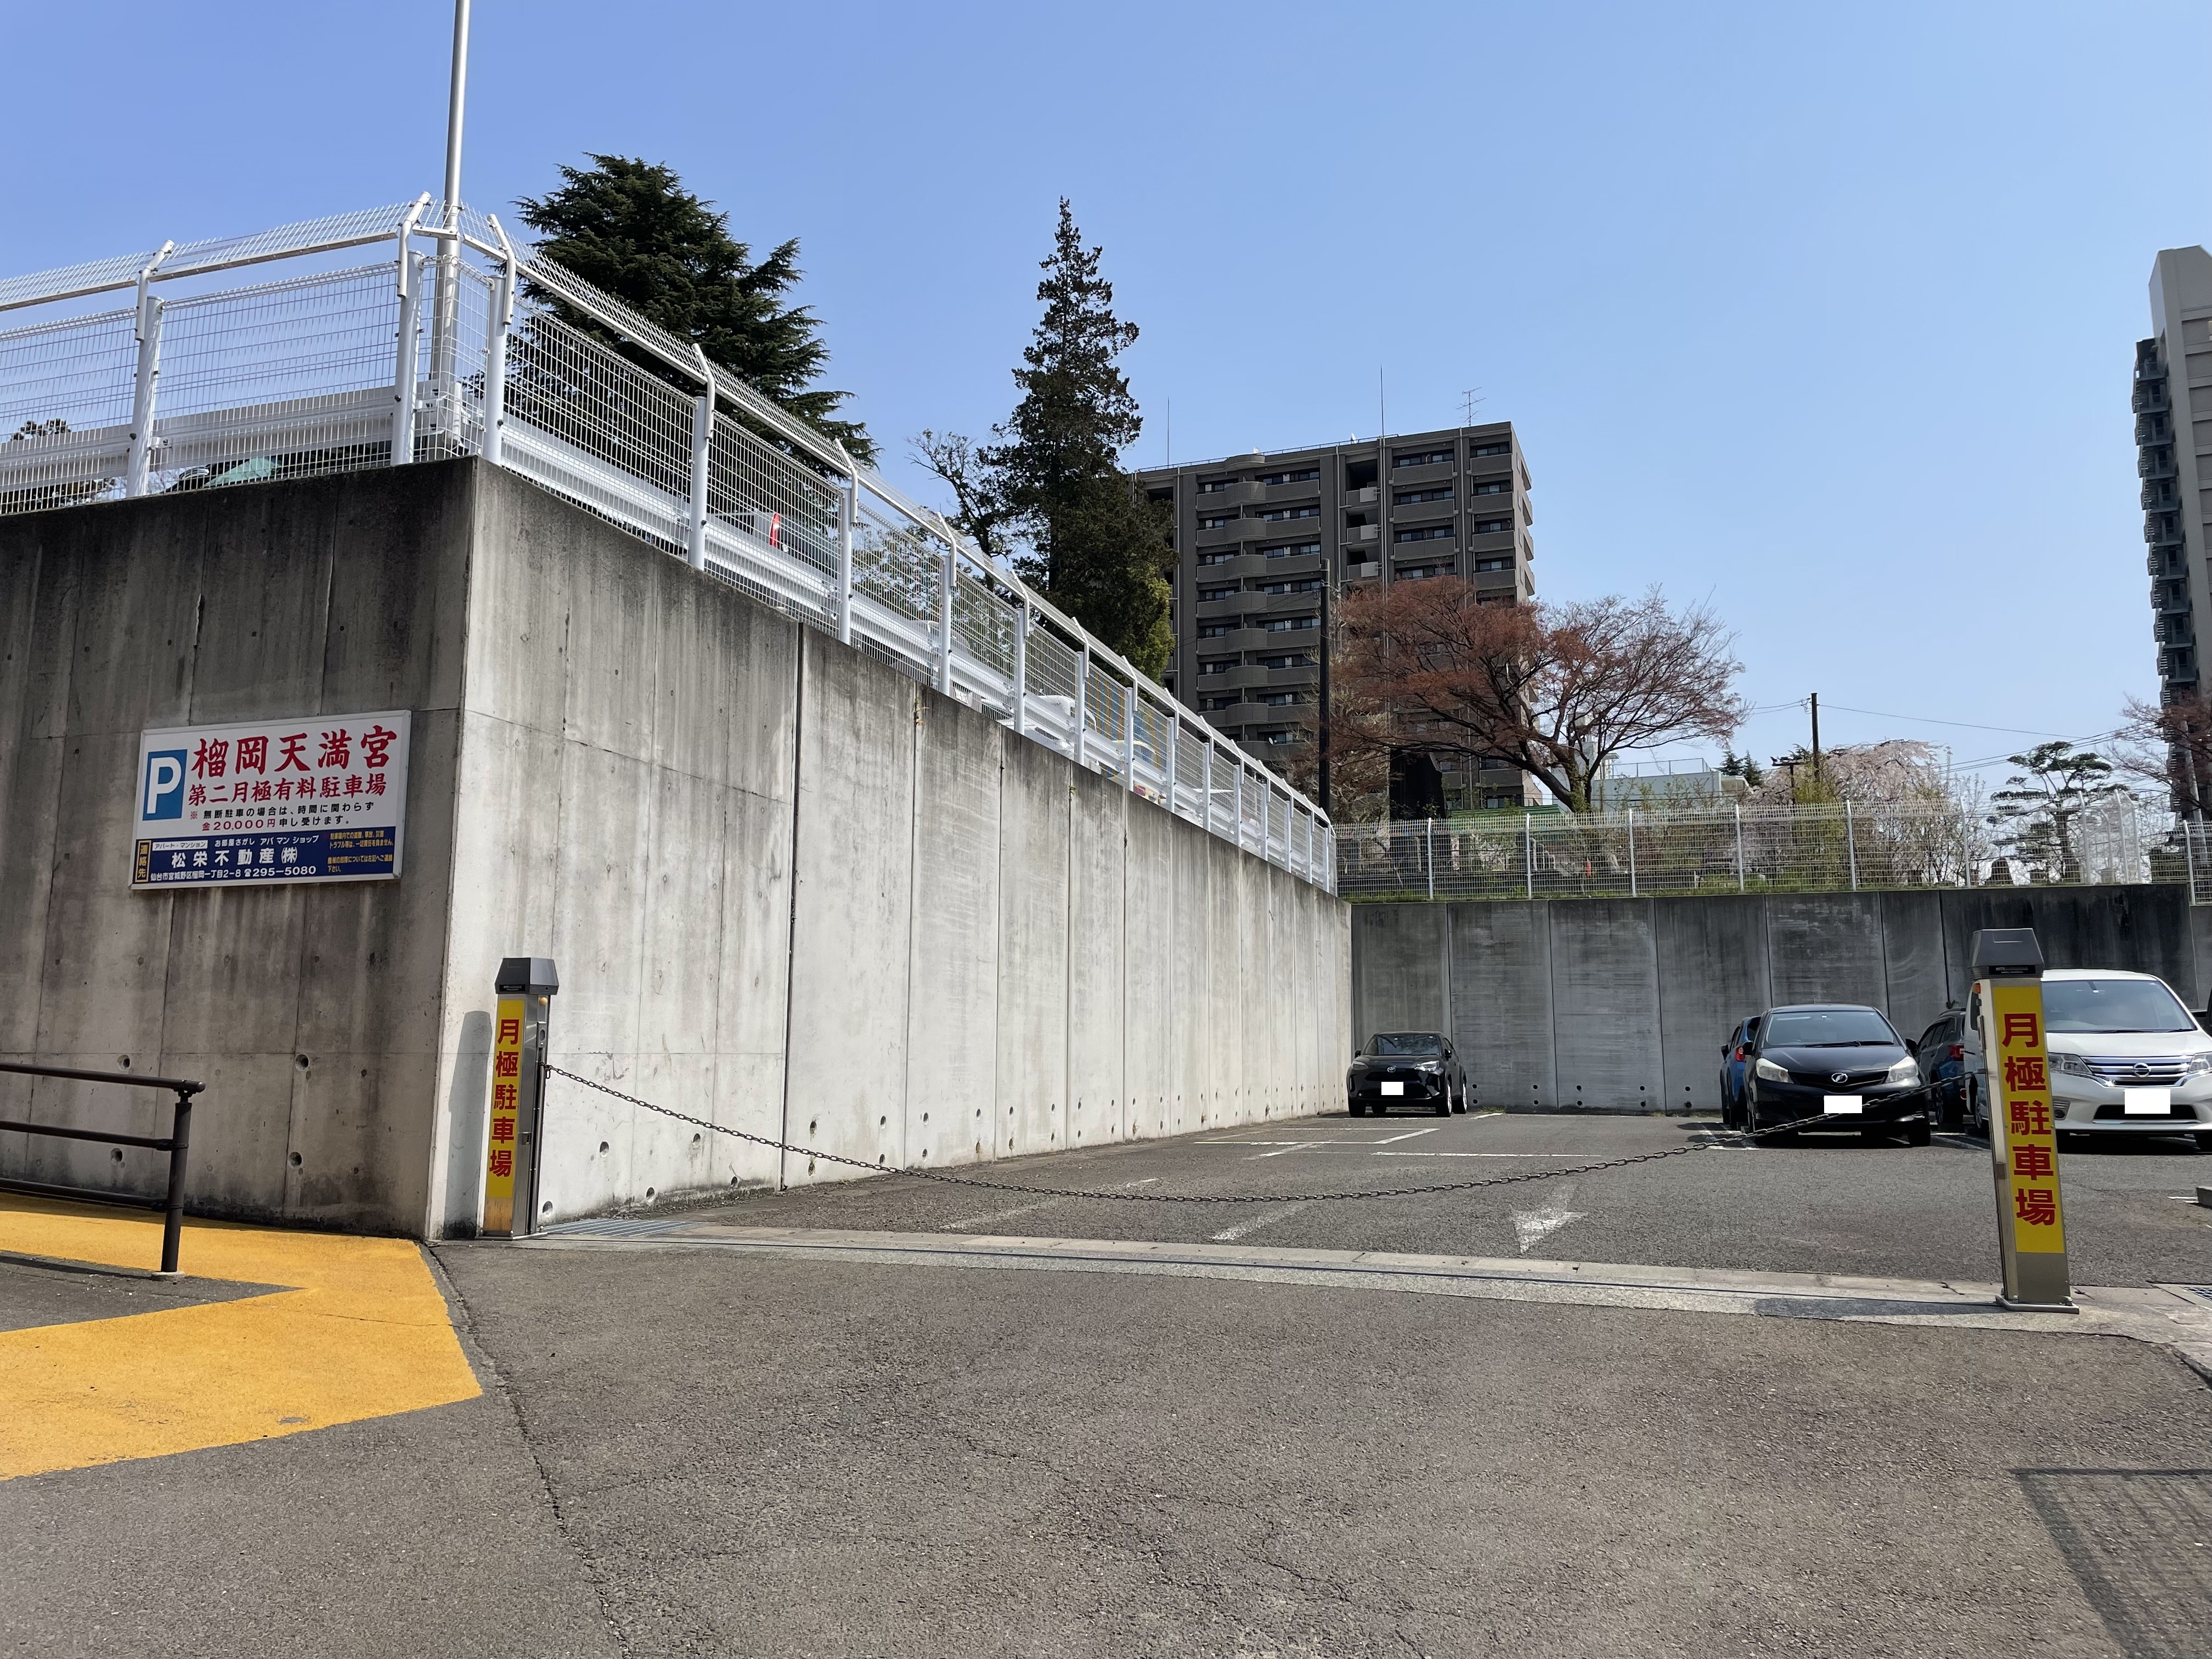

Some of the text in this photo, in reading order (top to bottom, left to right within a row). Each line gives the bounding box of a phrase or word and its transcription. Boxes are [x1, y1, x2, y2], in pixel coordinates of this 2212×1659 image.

[191, 725, 397, 779] 榴岡天満宮
[147, 757, 182, 814] P
[189, 773, 387, 806] 第二月極有料駐車場
[489, 1019, 520, 1177] 月極駐車場
[2002, 1013, 2056, 1226] 月極駐車場
